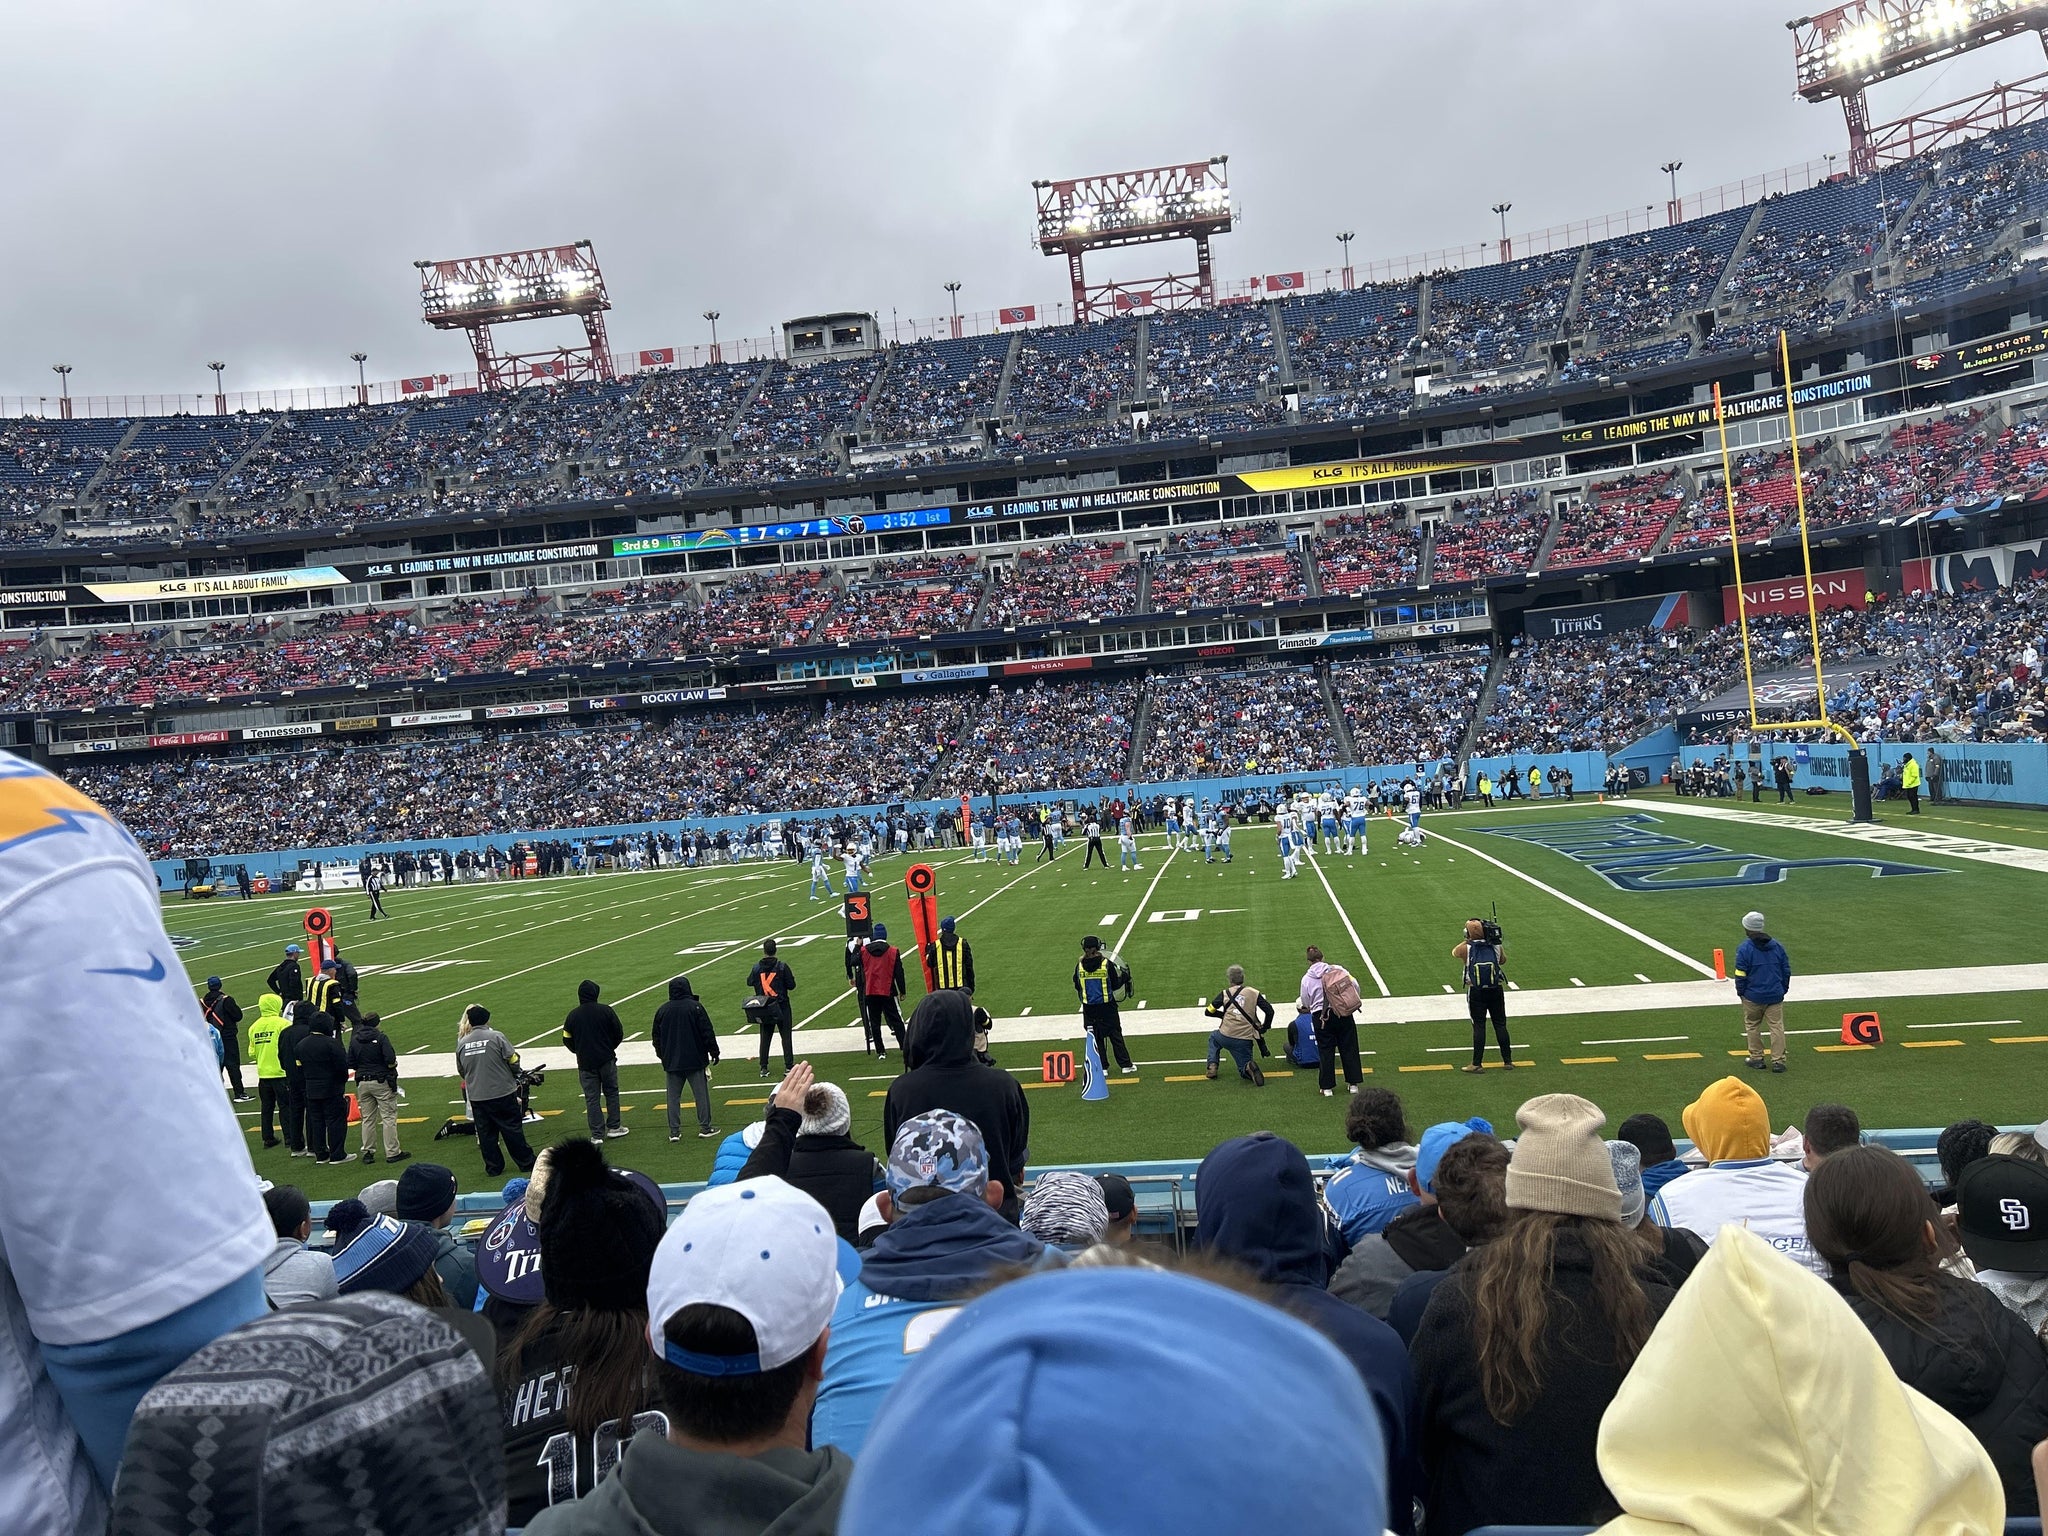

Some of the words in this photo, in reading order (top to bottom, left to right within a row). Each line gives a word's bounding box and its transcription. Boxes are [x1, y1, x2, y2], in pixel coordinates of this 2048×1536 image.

[2012, 335, 2031, 345] QTR
[2000, 350, 2017, 361] (SF)
[1561, 430, 1593, 443] KLG
[1603, 421, 1647, 441] LEADING
[1649, 416, 1670, 432] THE
[1672, 411, 1695, 428] WAY
[1698, 408, 1710, 423] IN
[1313, 467, 1343, 479] KLG
[1351, 464, 1369, 478] IT'S
[1371, 462, 1390, 475] ALL
[967, 505, 994, 517] KLG
[1002, 500, 1040, 516] LEADING
[1041, 498, 1060, 512] THE
[1060, 496, 1079, 510] WAY
[1082, 494, 1091, 508] IN
[1094, 488, 1151, 506] HEALTHCARE
[1152, 481, 1220, 500] CONSTRUCTION
[882, 511, 917, 529] 3:52
[925, 512, 941, 523] 1st
[757, 527, 767, 540] 7
[800, 523, 810, 536] 7
[622, 540, 640, 551] 3rd
[641, 539, 651, 549] &
[651, 538, 660, 548] 9
[672, 539, 681, 547] 13
[367, 564, 393, 574] KLG
[400, 560, 434, 574] LEADING
[435, 558, 452, 571] THE
[452, 556, 470, 568] WAY
[472, 555, 481, 567] IN
[483, 549, 535, 566] HEALTHCARE
[536, 544, 599, 560] CONSTRUCTION
[159, 583, 187, 593] KLG
[194, 581, 210, 593] IT'S
[213, 580, 230, 592] ALL
[232, 578, 260, 590] ABOUT
[261, 575, 288, 588] FAMILY
[1741, 580, 1846, 605] NISSAN
[1550, 613, 1602, 636] TITANS
[1197, 645, 1235, 656] verizon
[1279, 638, 1317, 649] Pinnacle
[1031, 661, 1064, 670] NISSAN
[1246, 655, 1268, 664] MIKE
[930, 669, 976, 680] Gallagher
[589, 699, 617, 709] FedEx
[641, 692, 679, 704] ROCKY
[680, 690, 705, 701] LAW
[1809, 757, 1837, 777] TENNESSEE
[1985, 759, 2013, 786] TOUGH
[1353, 801, 1365, 811] 76
[1283, 818, 1291, 829] 10
[848, 897, 868, 921] 3
[760, 972, 778, 997] K
[1850, 1015, 1881, 1043] G
[464, 1039, 490, 1050] BEST
[1045, 1053, 1072, 1080] 10
[1999, 1198, 2030, 1230] SD
[504, 1249, 541, 1284] TIT
